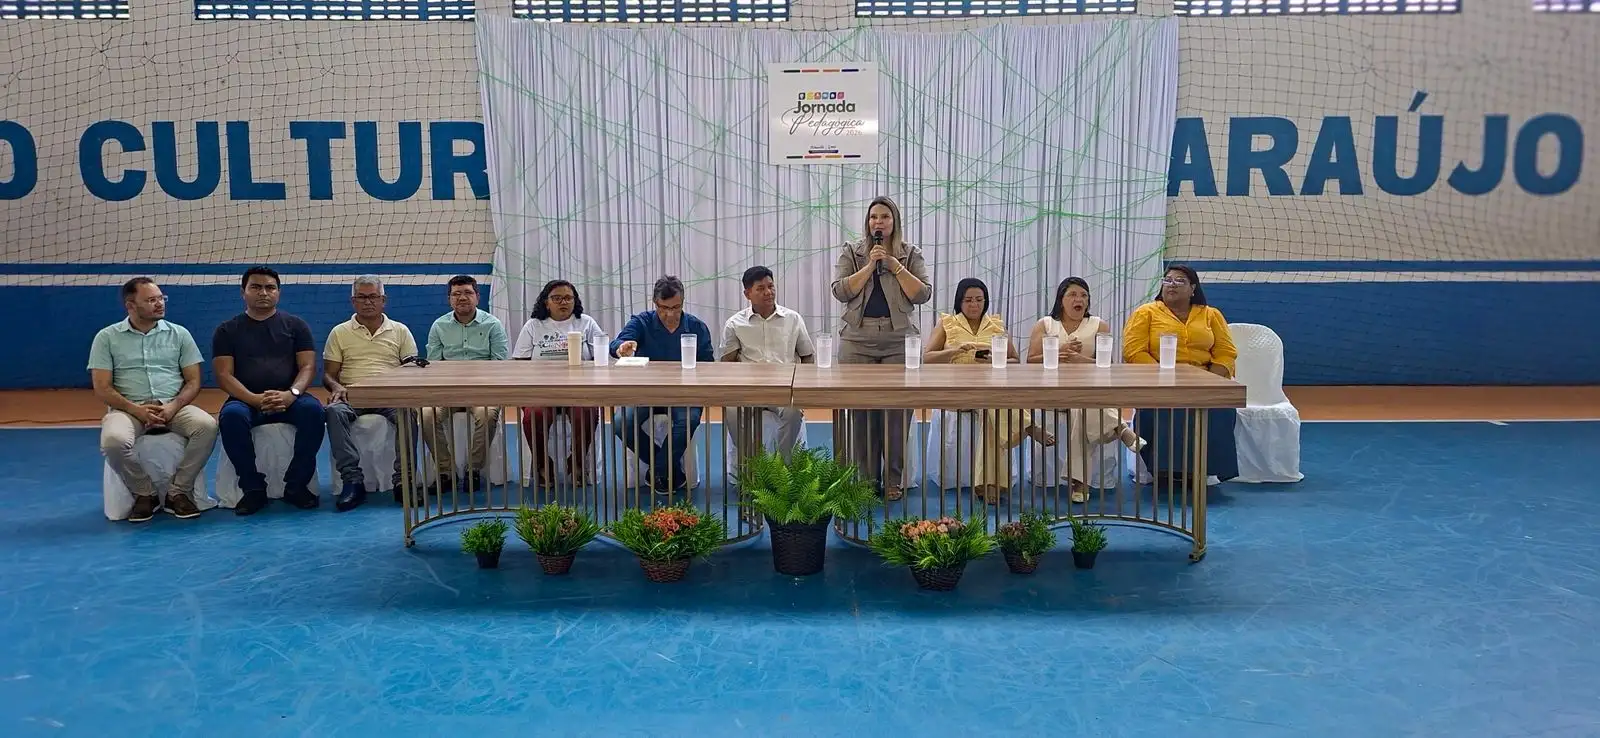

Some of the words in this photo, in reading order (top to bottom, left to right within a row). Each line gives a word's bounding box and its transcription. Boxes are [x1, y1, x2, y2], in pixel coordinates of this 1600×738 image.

[793, 100, 856, 114] Jornada
[79, 120, 491, 201] CULTUR
[1167, 90, 1584, 196] ARAÚJO
